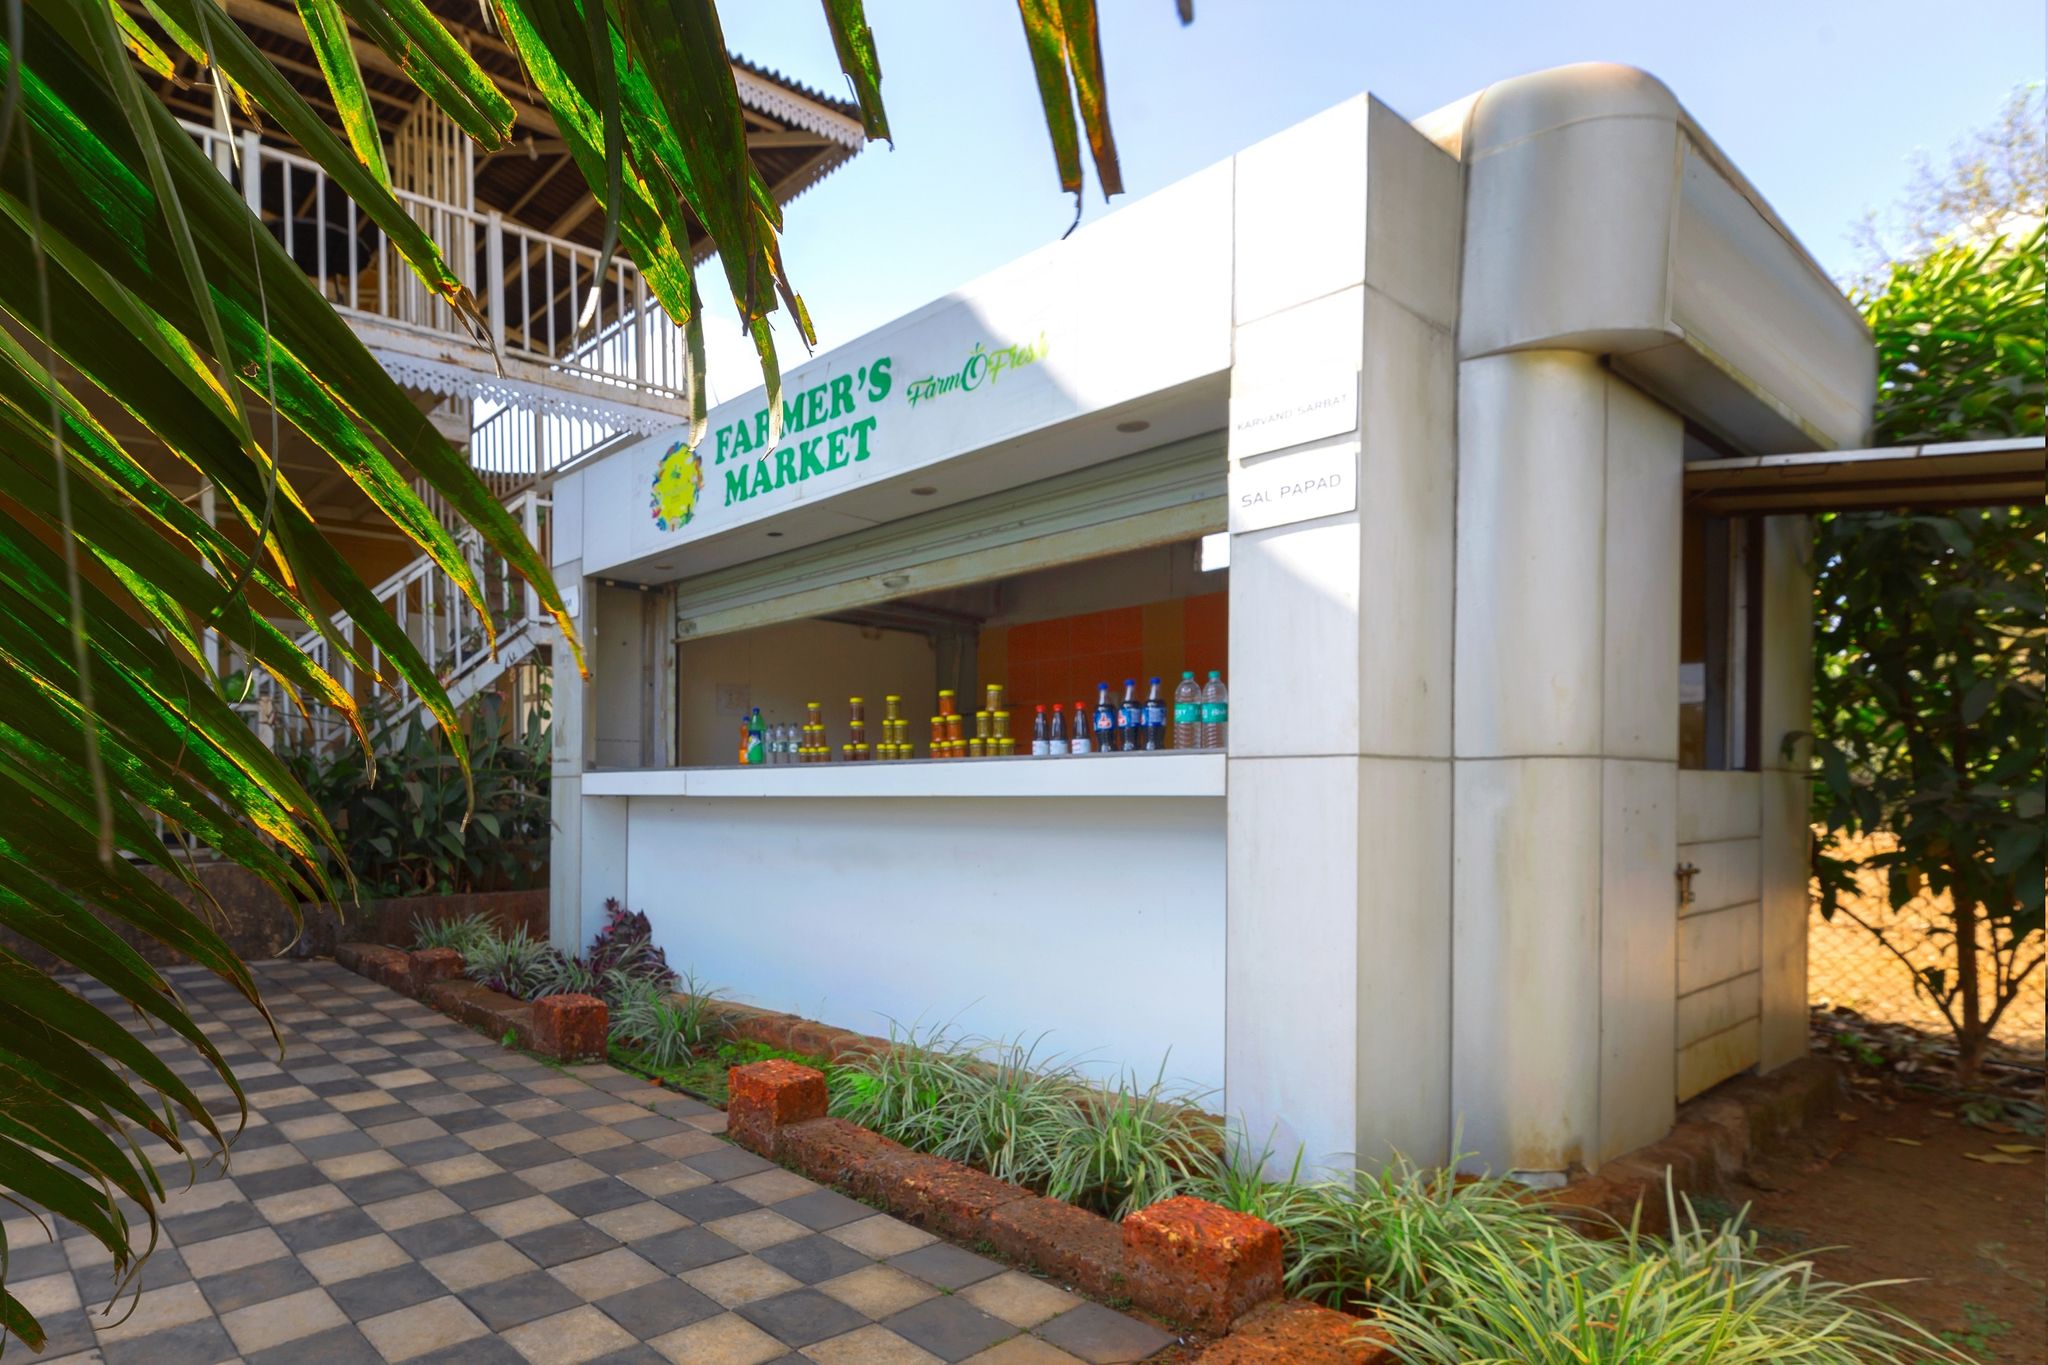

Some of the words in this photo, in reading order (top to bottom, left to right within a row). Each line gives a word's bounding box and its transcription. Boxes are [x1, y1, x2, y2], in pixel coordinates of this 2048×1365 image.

[724, 416, 877, 507] MARKET
[1241, 489, 1273, 508] SAL
[1280, 473, 1342, 499] PAPAD
